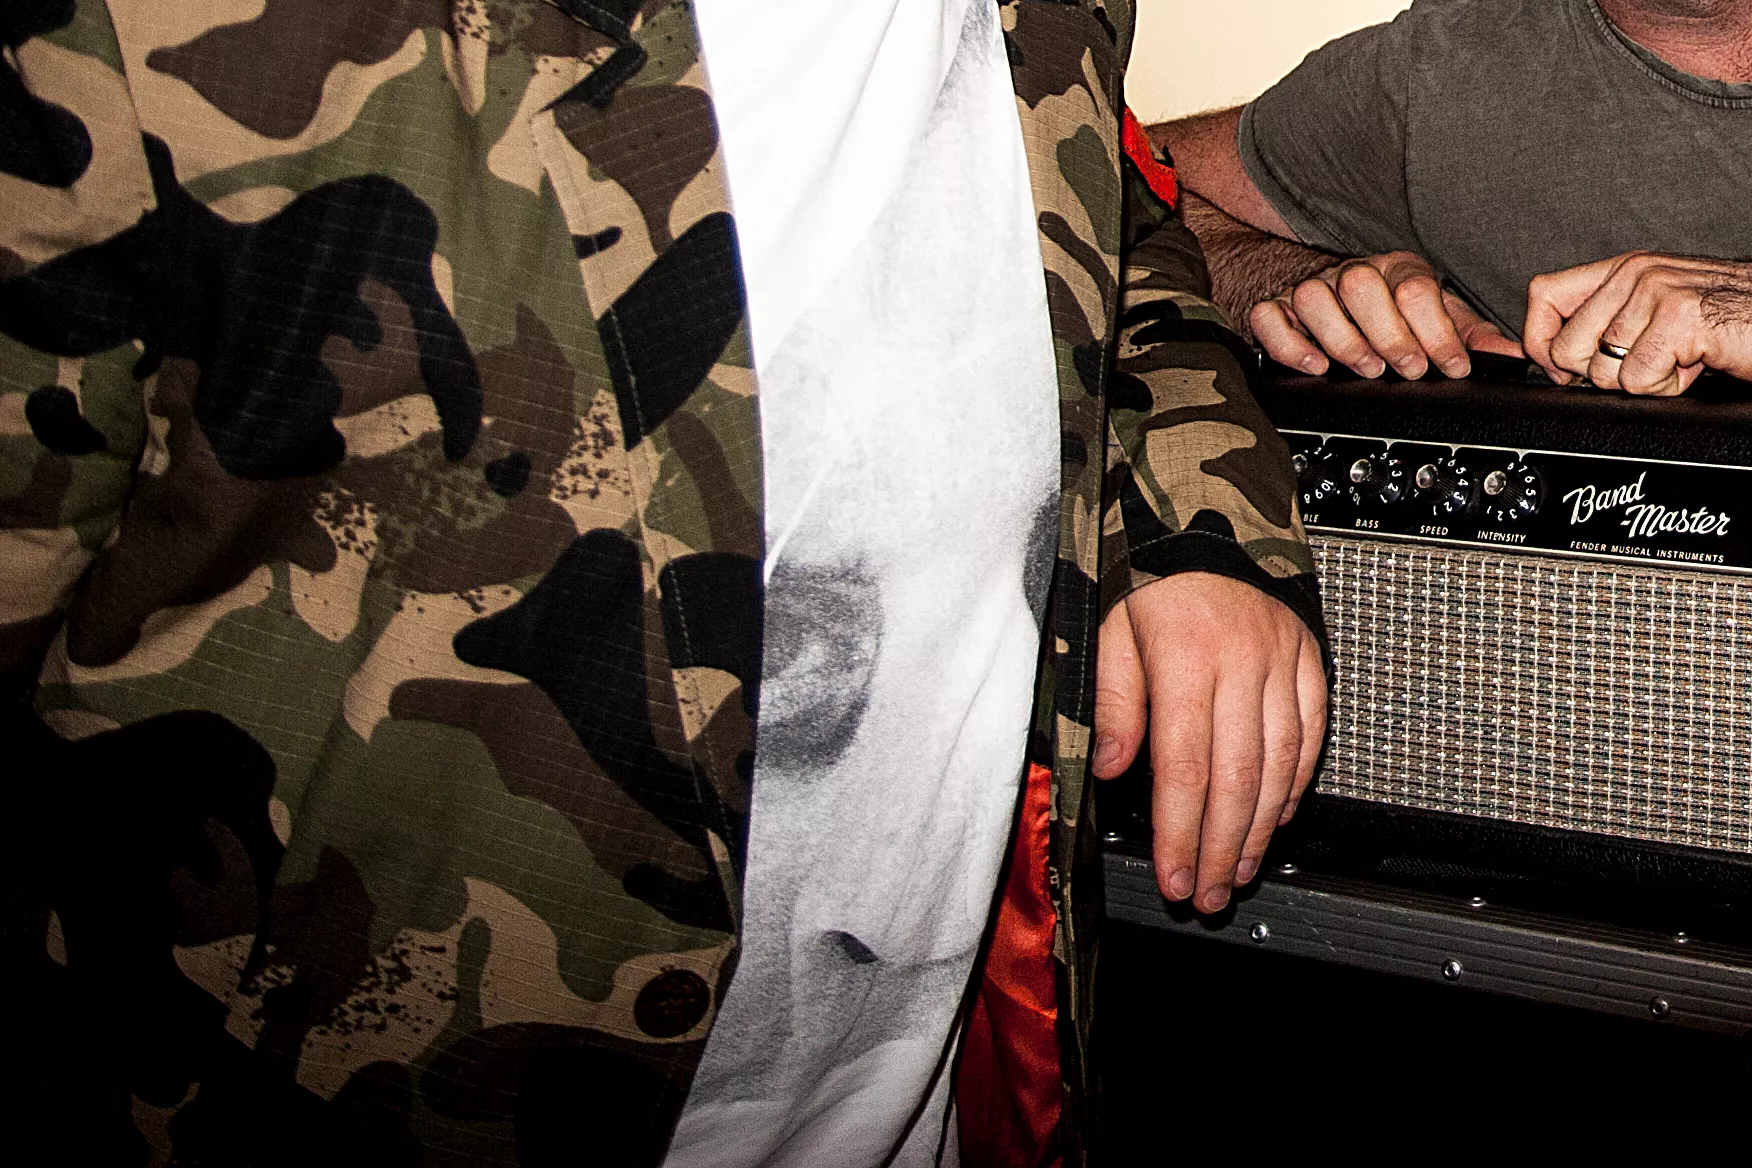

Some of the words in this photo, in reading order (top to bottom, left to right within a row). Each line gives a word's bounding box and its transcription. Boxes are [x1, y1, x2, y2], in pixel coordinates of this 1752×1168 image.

[1562, 470, 1647, 525] Band
[1355, 518, 1379, 529] BASS
[1420, 525, 1449, 536] SPEED
[1477, 530, 1526, 543] INTENSITY
[1570, 540, 1607, 552] FENDER
[1611, 544, 1651, 556] MUSICAL
[1656, 549, 1725, 563] INSTRUMENTS
